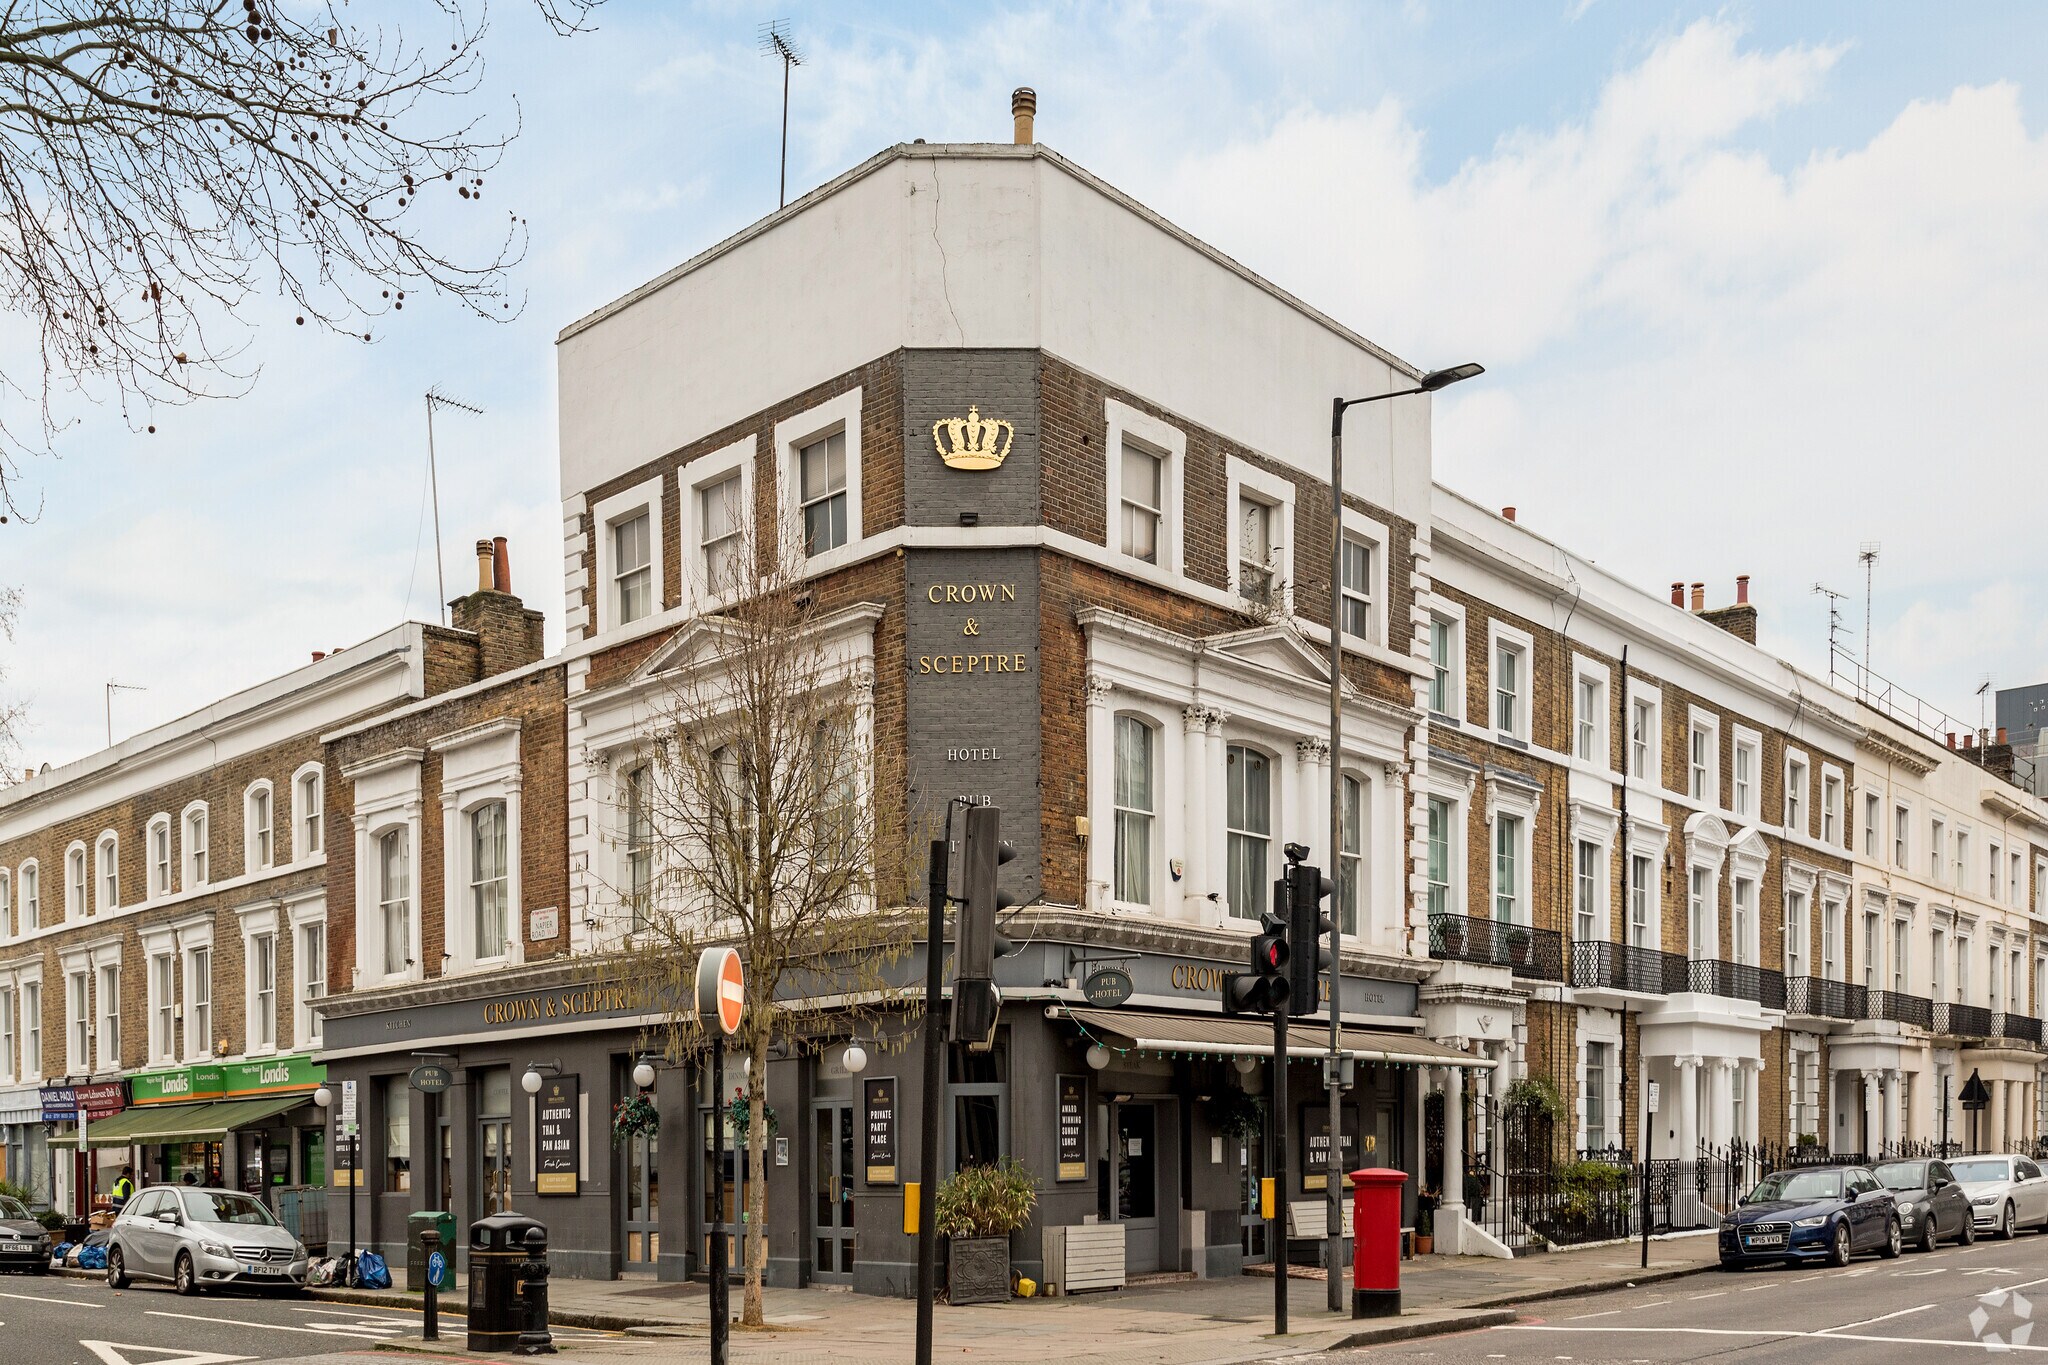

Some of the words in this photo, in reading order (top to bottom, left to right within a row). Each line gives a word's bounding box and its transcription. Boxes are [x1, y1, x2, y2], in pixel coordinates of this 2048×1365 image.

[928, 584, 1015, 603] CROWN
[963, 618, 980, 636] &
[920, 654, 1027, 674] SCEPTRE
[947, 748, 1001, 761] HOTEL
[959, 795, 991, 807] PUB
[535, 920, 553, 930] NAPIER
[532, 930, 545, 939] ROAD
[1101, 977, 1117, 986] PUB
[1095, 989, 1122, 999] HOTEL
[484, 998, 542, 1024] CROWN
[546, 996, 557, 1017] &
[196, 1073, 220, 1081] Londis
[260, 1062, 289, 1084] Londis
[162, 1074, 189, 1094] Londis
[41, 1092, 60, 1102] DANIEL
[60, 1091, 75, 1101] PAOLI
[542, 1108, 571, 1120] AUTHENTIC
[1062, 1105, 1077, 1113] AWARD
[870, 1110, 892, 1120] PRIVATE
[1062, 1116, 1082, 1124] WINNING
[542, 1125, 555, 1136] THAI
[556, 1124, 561, 1135] &
[870, 1123, 887, 1132] PARTY
[1062, 1127, 1079, 1135] SUNDAY
[870, 1135, 887, 1144] PLACE
[1062, 1138, 1077, 1146] LUNCH
[1309, 1136, 1330, 1147] AUTHEN
[1340, 1135, 1352, 1147] THAI
[542, 1140, 553, 1151] PAN
[554, 1139, 570, 1151] ASIAN
[1309, 1151, 1314, 1163] &
[1315, 1151, 1327, 1163] PAN
[1751, 1236, 1766, 1244] WP15
[253, 1266, 267, 1274] BF12
